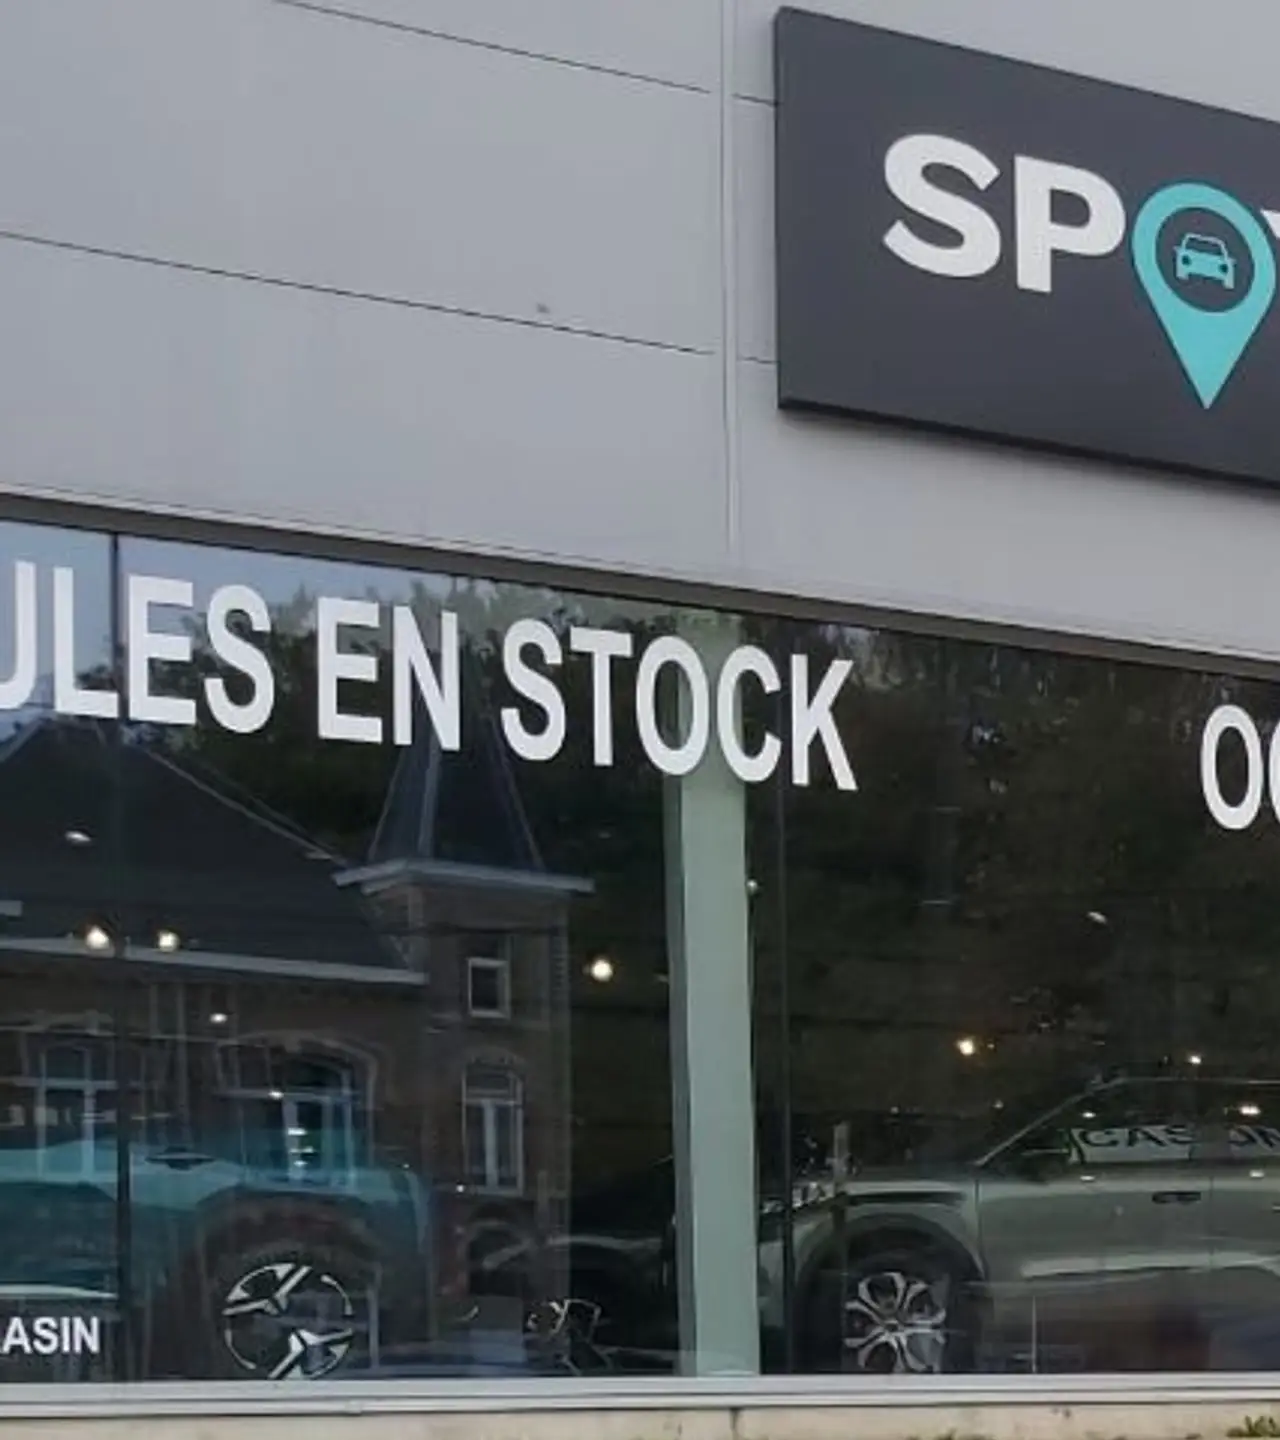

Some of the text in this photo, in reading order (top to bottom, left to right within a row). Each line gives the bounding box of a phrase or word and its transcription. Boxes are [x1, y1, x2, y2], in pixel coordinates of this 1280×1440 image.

[317, 596, 461, 752] EN
[500, 618, 858, 792] STOCK
[1, 1316, 100, 1354] ASIN
